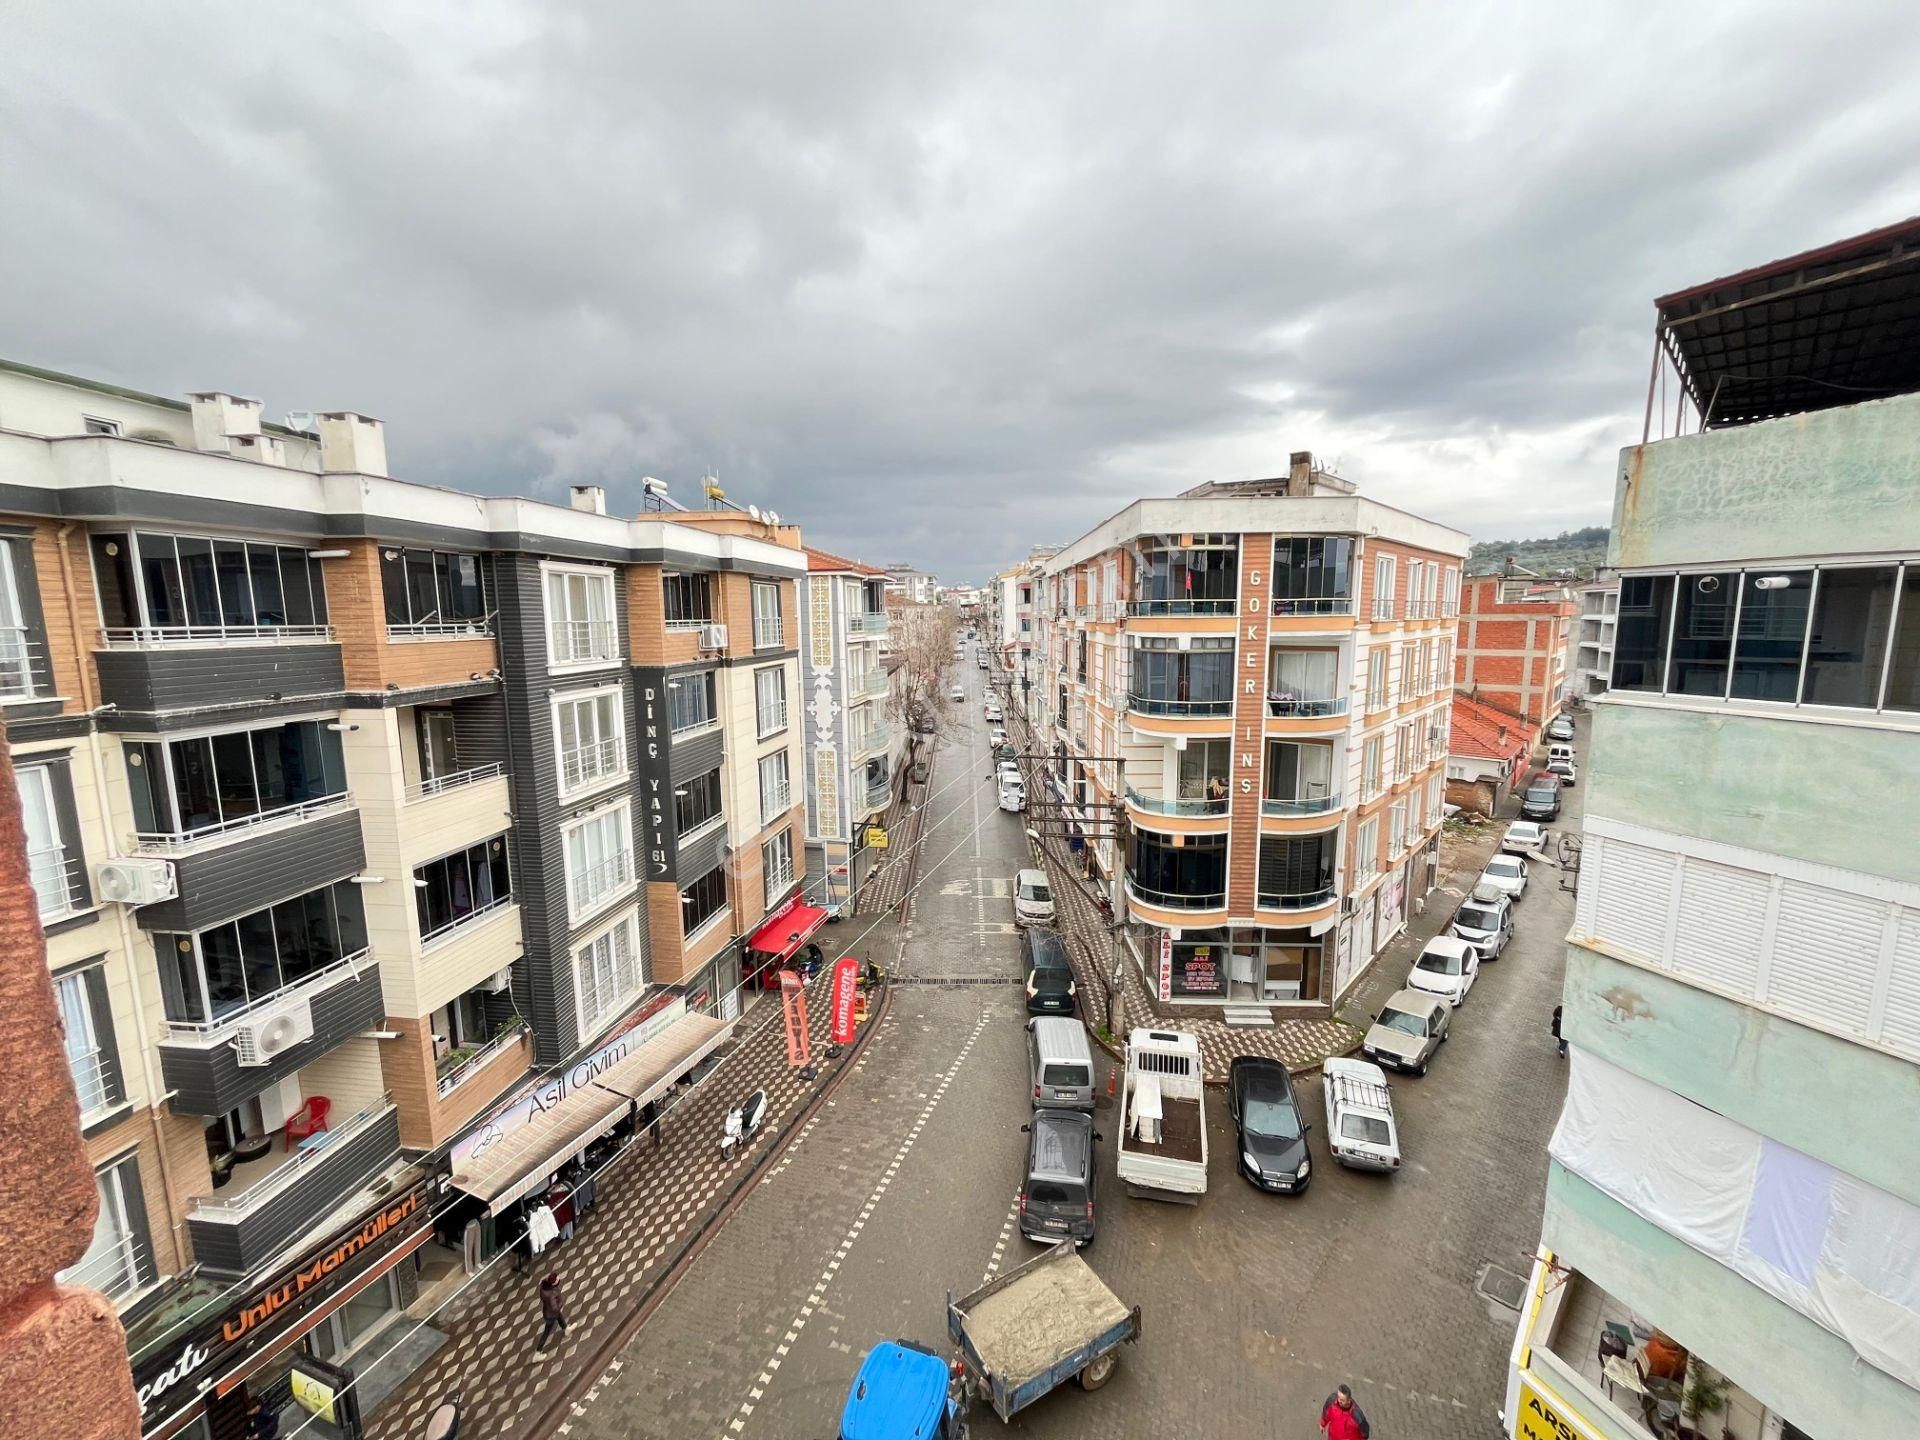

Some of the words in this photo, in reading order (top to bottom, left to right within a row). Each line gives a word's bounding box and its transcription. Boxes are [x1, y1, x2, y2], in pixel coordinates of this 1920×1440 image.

[644, 688, 658, 759] DİNÇ
[649, 779, 662, 845] YAPI
[652, 849, 666, 862] 61
[1185, 962, 1216, 971] SPOT
[834, 967, 853, 1037] komagene
[528, 1079, 567, 1124] Asil
[222, 1288, 290, 1342] Unlu
[296, 1193, 417, 1293] Mamülleri
